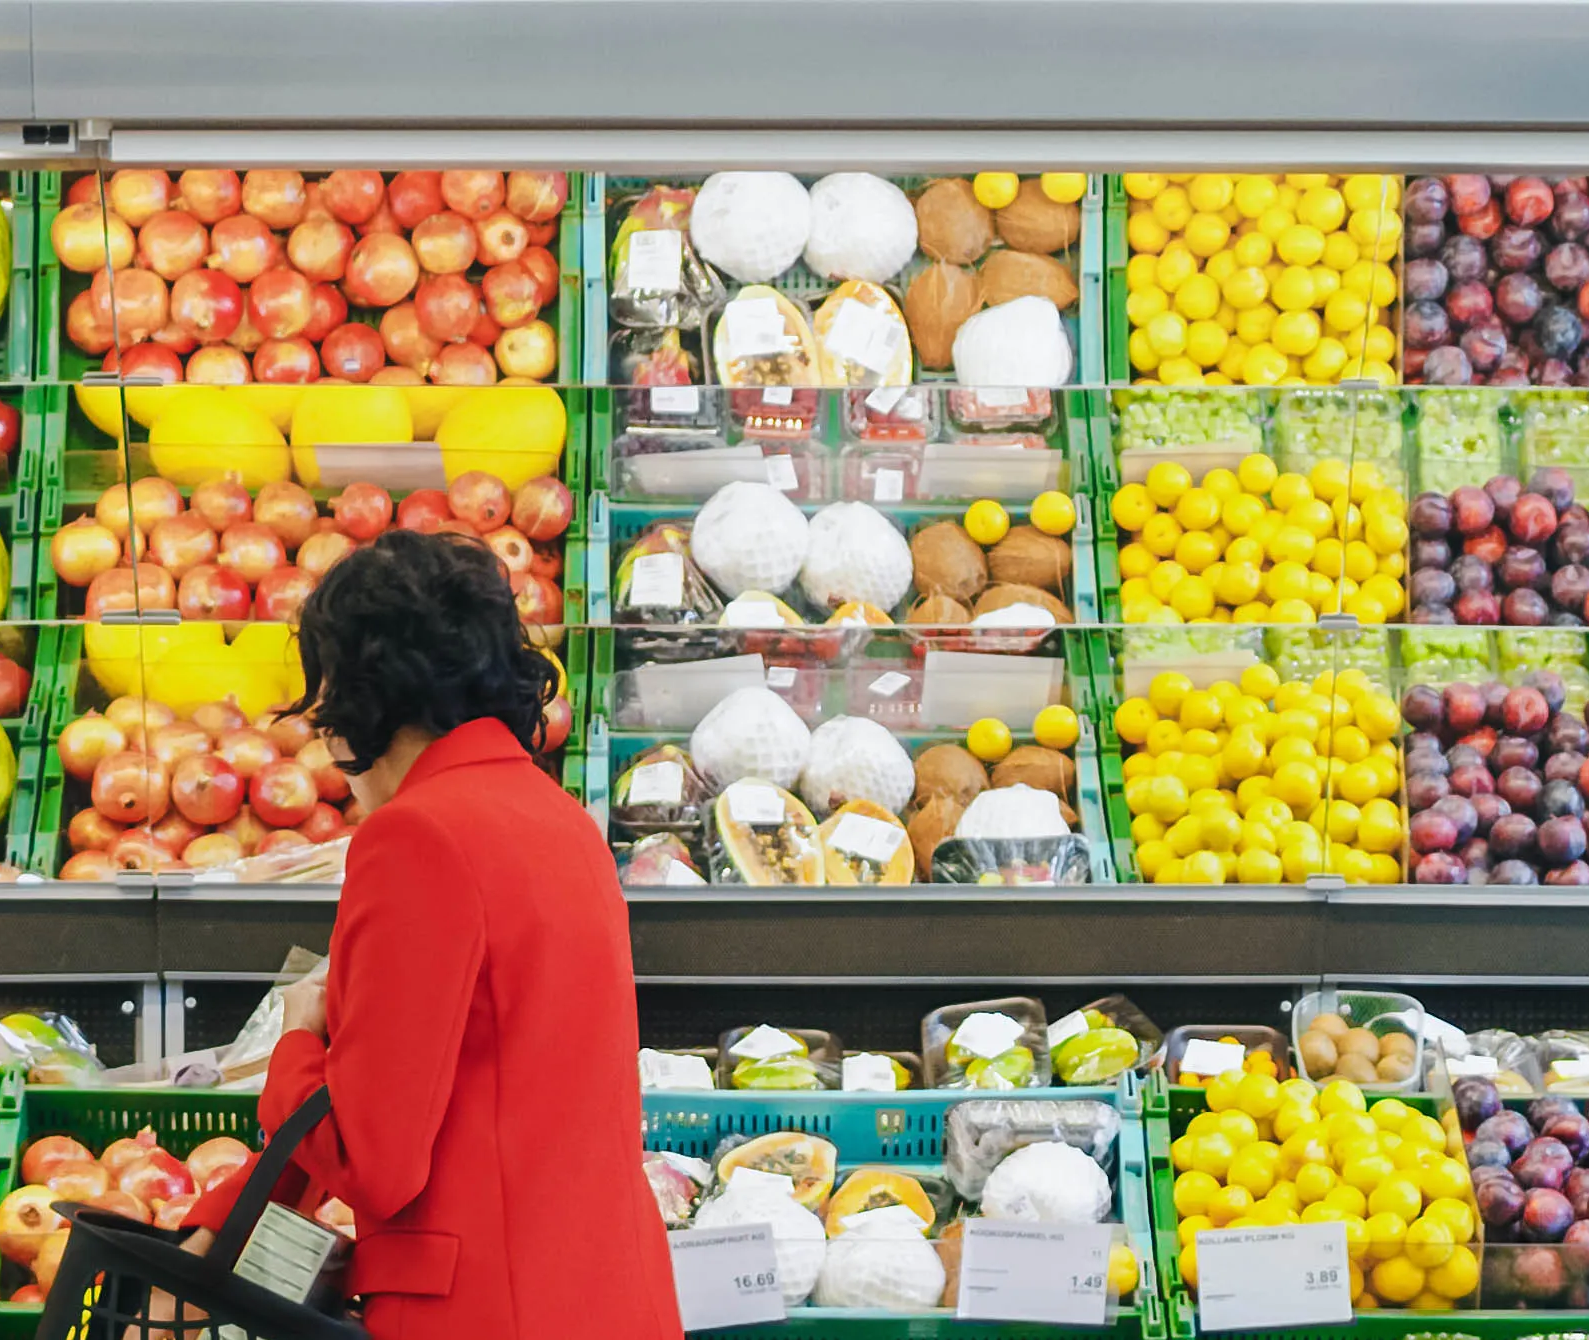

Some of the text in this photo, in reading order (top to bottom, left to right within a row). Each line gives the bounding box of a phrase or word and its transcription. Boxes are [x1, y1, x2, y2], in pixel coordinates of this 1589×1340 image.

[733, 1271, 776, 1289] 16.69
[1071, 1274, 1103, 1288] 1.49
[1305, 1269, 1339, 1284] 3.89
